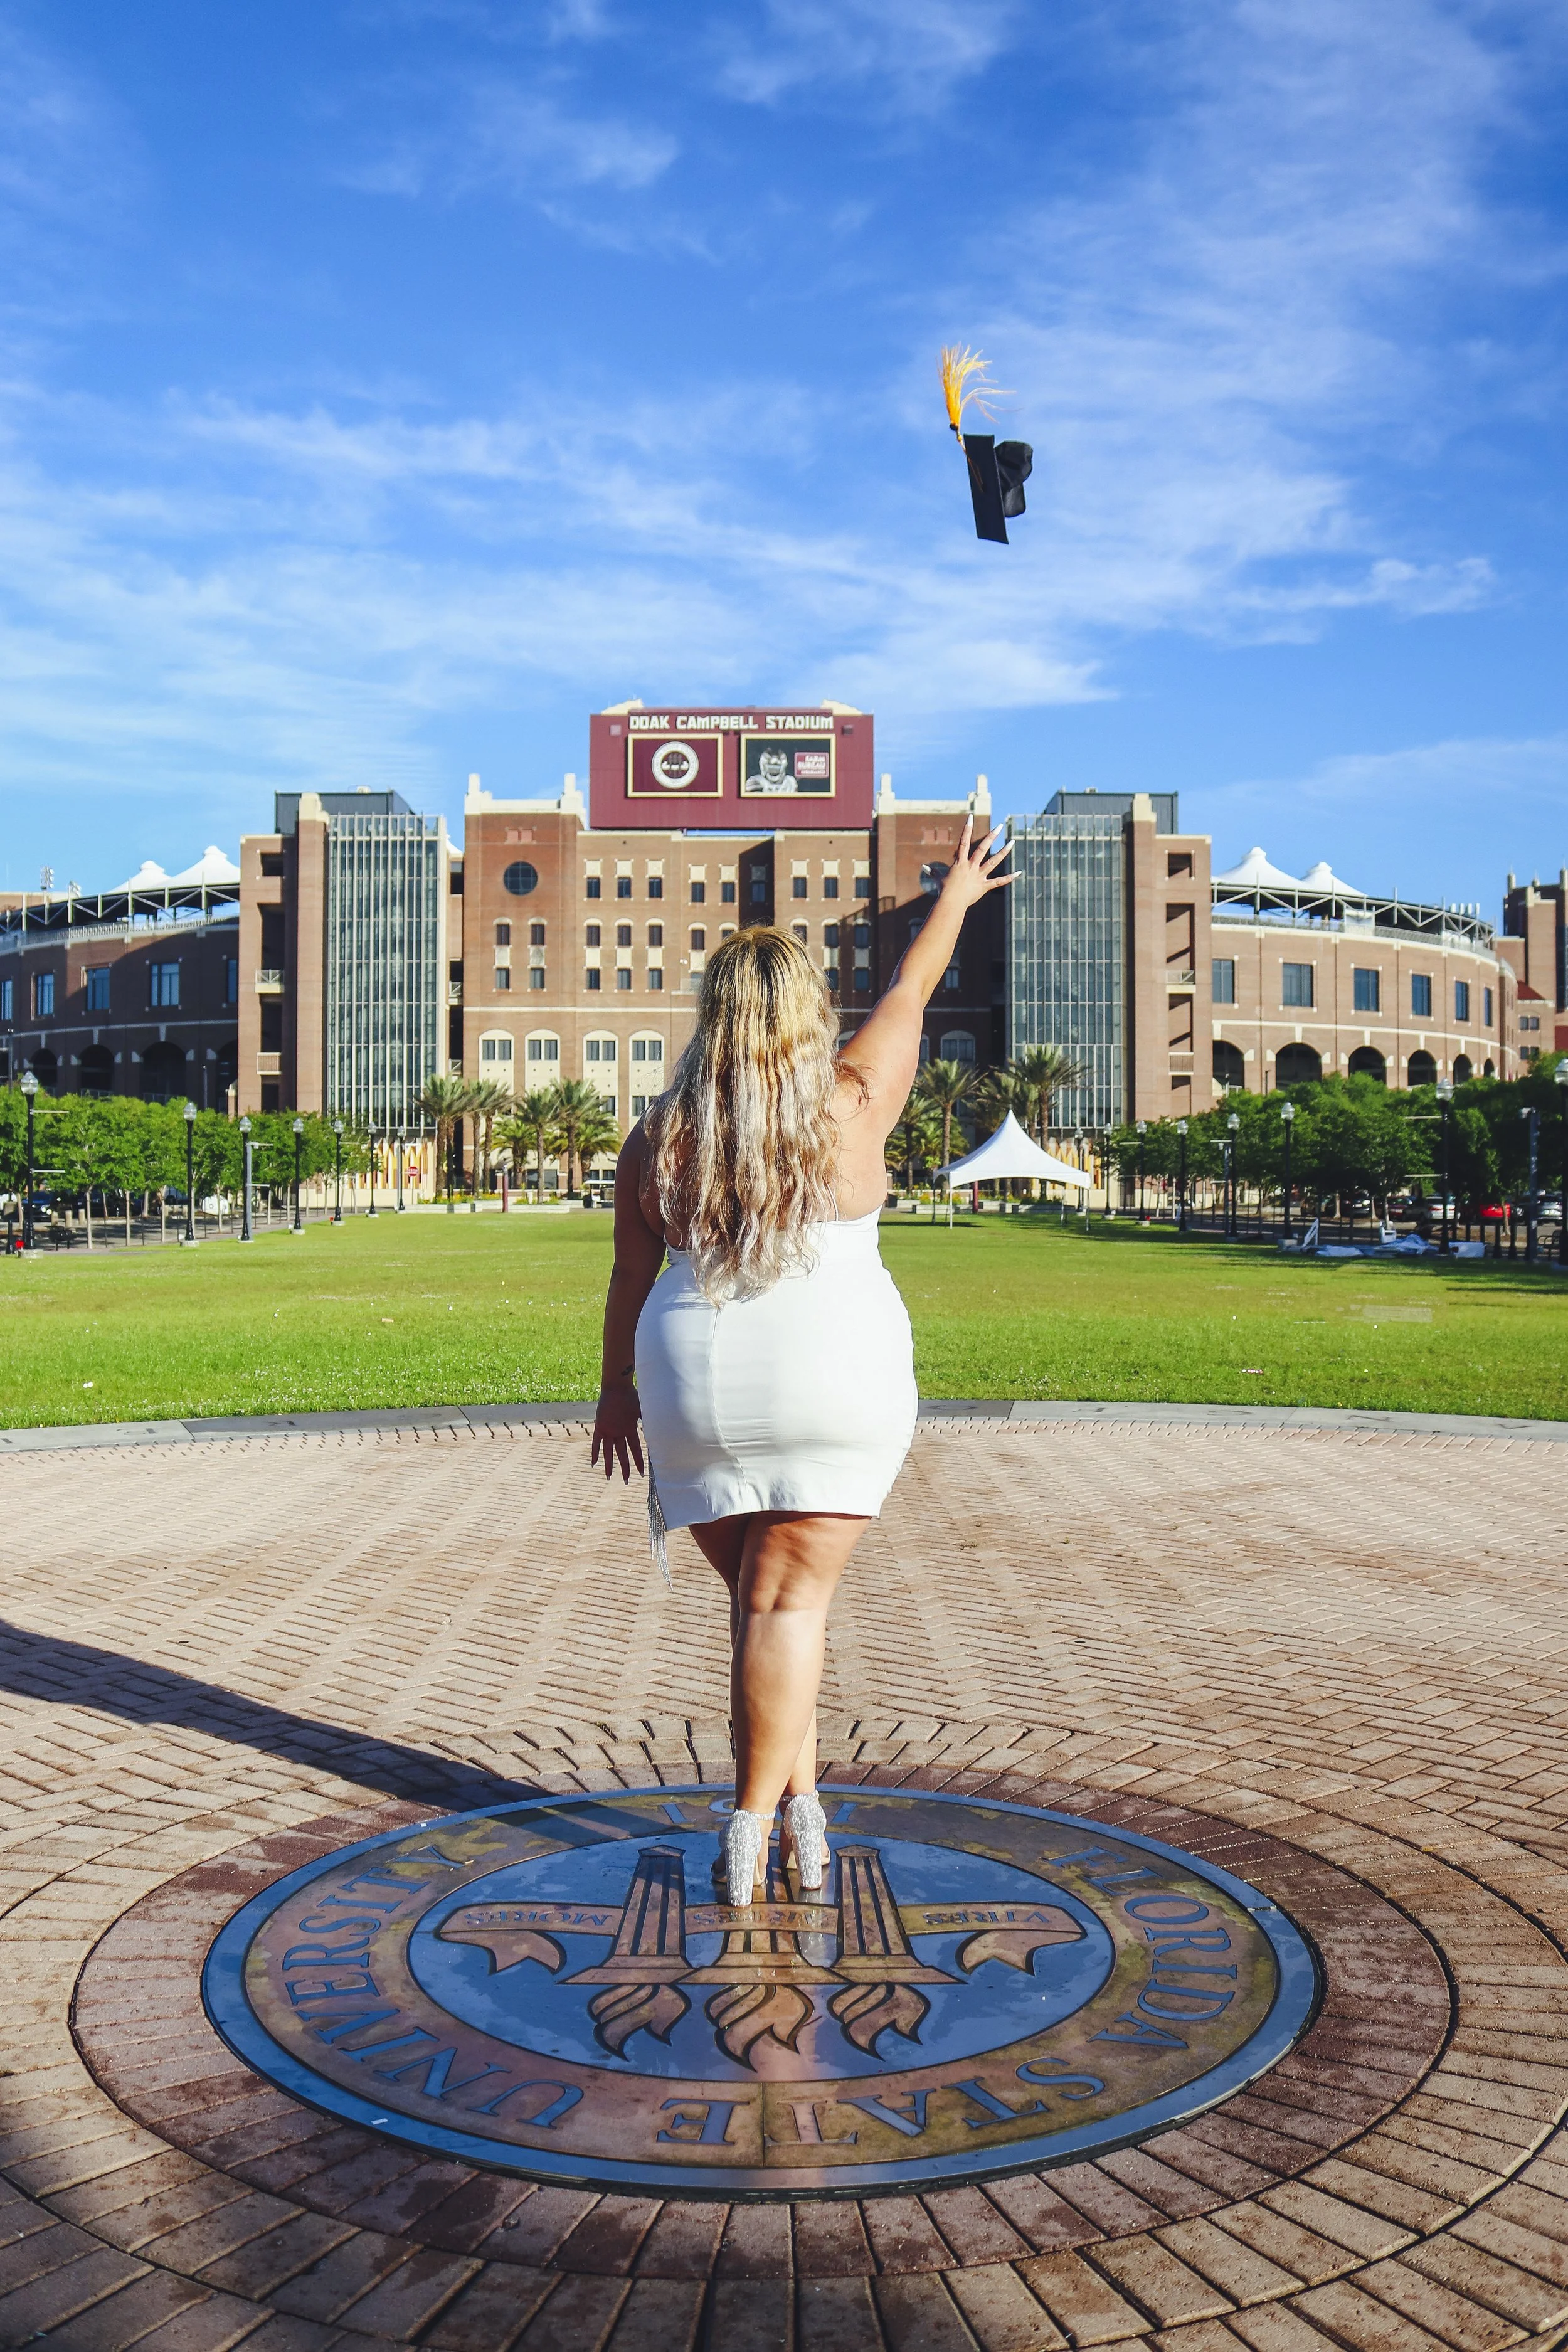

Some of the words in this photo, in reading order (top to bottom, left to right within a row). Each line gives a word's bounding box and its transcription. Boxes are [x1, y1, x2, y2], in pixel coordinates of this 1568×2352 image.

[629, 715, 670, 729] DOAK
[675, 715, 758, 729] CAMPBELL
[765, 715, 834, 729] STADIUM
[464, 1910, 612, 1926] MORES
[923, 1910, 1059, 1925] VIRES
[1041, 1845, 1238, 2049] FLORIDA
[282, 1845, 584, 2129] UNIVERSITY
[655, 2057, 1105, 2146] STATE
